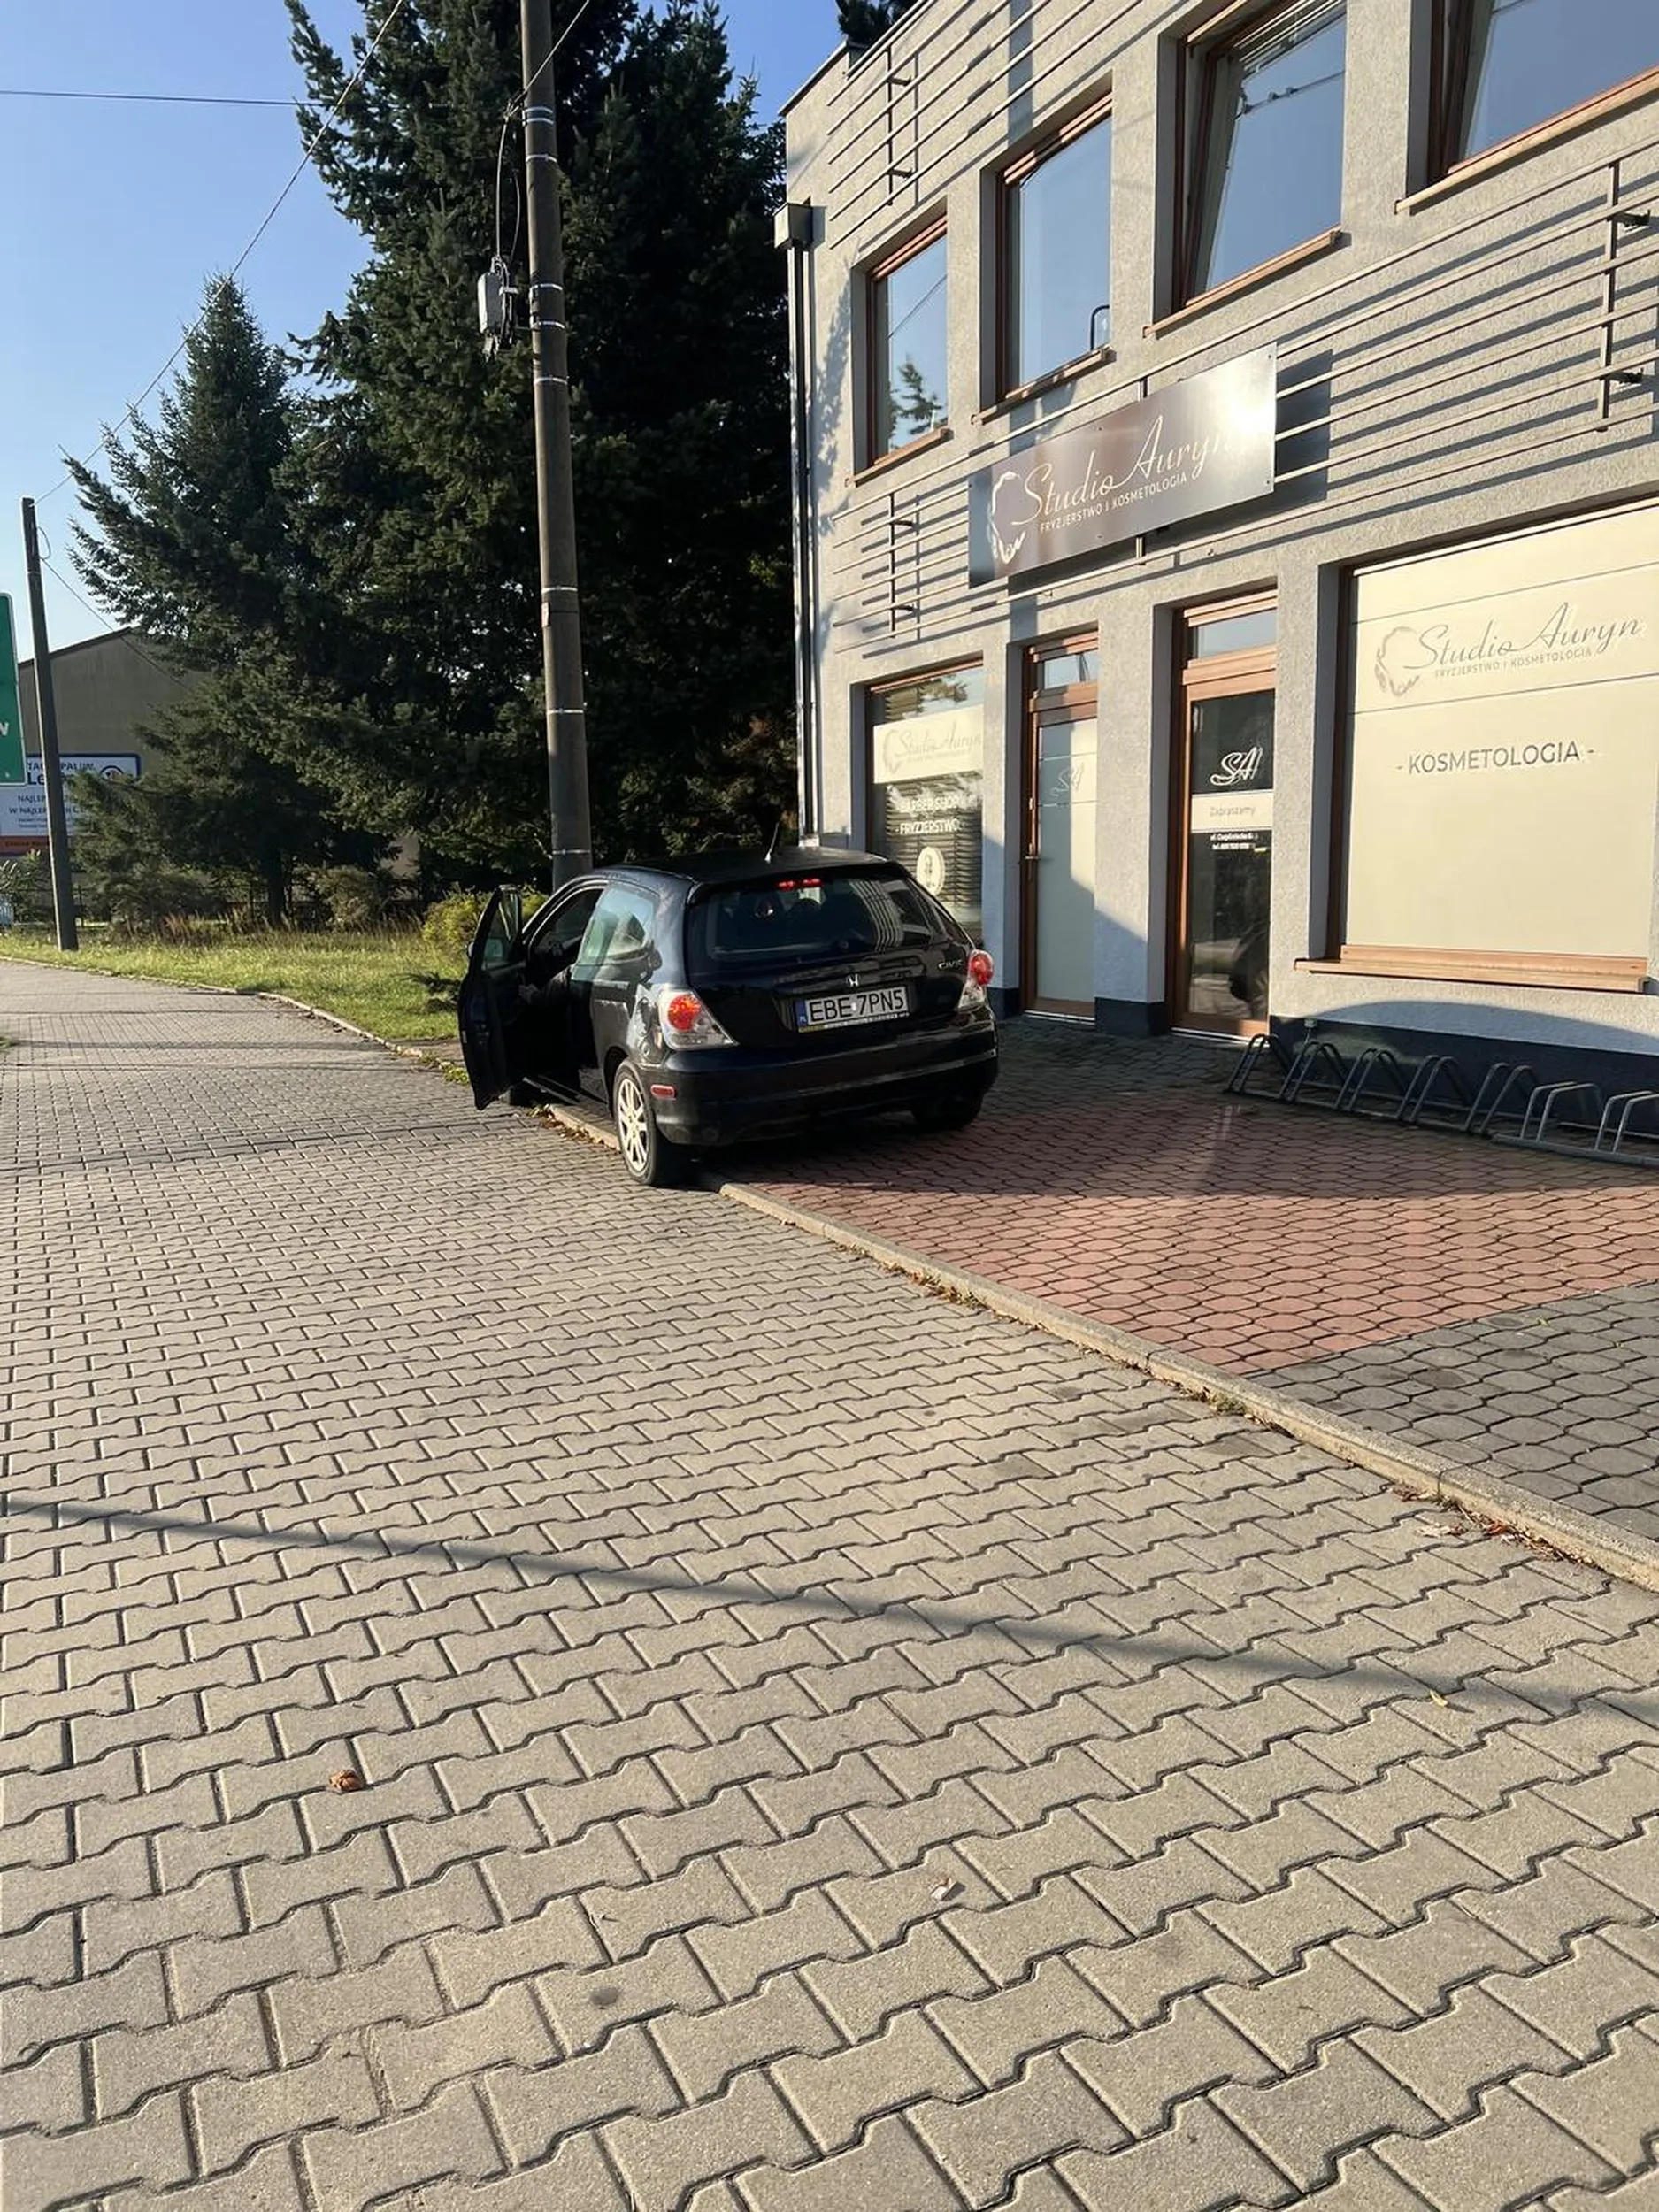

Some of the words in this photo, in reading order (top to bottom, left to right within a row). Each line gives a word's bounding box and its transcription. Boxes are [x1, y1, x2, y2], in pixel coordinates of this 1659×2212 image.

[1011, 450, 1116, 526] Studio
[1040, 504, 1102, 532] FRYZJERSTWO
[1111, 473, 1187, 510] KOSMETOLOGIA
[1403, 619, 1513, 670] Studio
[1514, 602, 1640, 653] Auryn
[1434, 660, 1501, 678] FRYZJERSTWO
[1510, 647, 1593, 669] KOSMETOLOGIA
[1409, 741, 1580, 775] KOSMETOLOGIA
[809, 996, 853, 1022] EBE
[856, 989, 904, 1016] 7PN5
